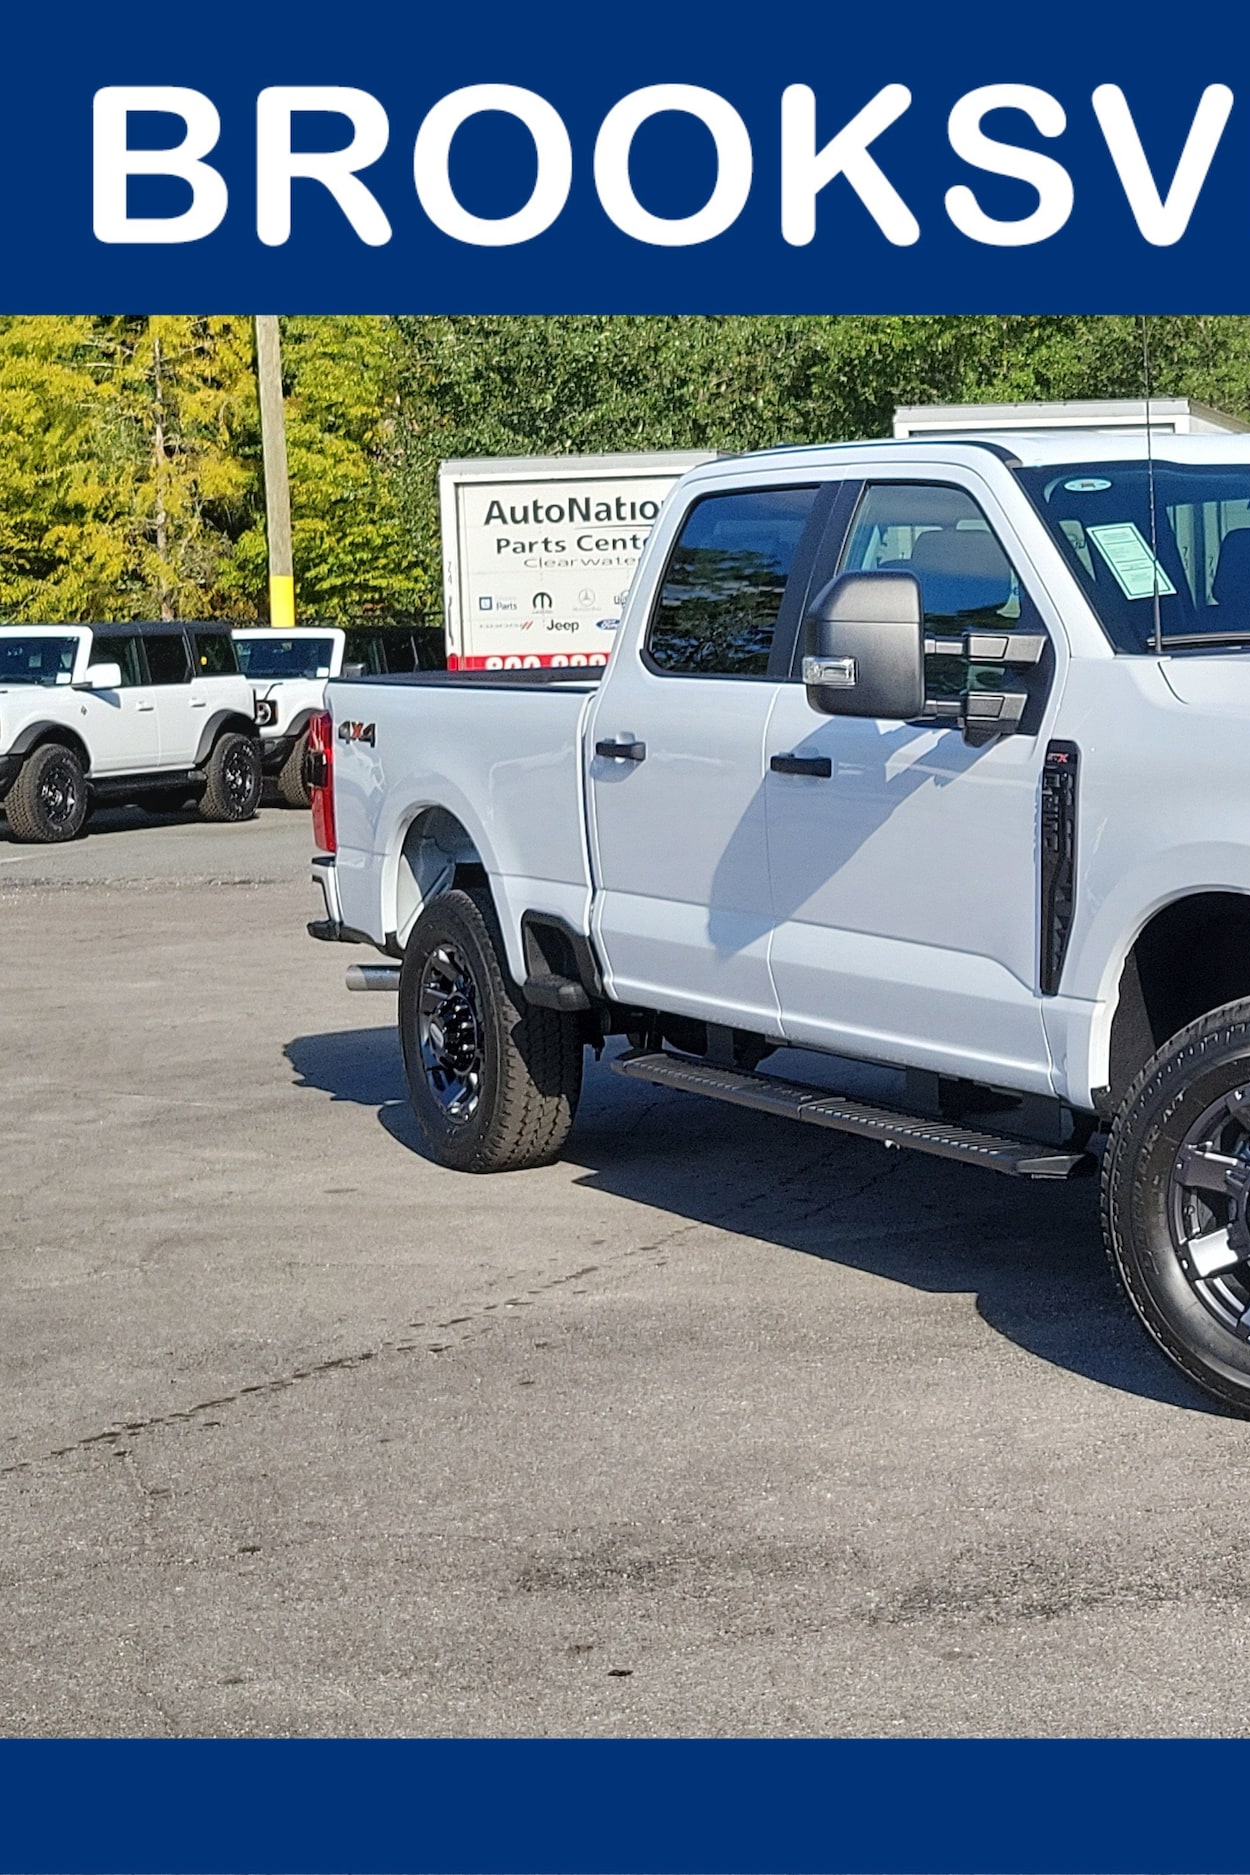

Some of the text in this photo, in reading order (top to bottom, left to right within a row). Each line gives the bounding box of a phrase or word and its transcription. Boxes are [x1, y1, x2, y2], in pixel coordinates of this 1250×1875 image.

[483, 495, 665, 526] AutoNatio
[496, 533, 650, 555] Parts Cent
[523, 555, 641, 569] Clearwate
[546, 618, 580, 634] Jeep
